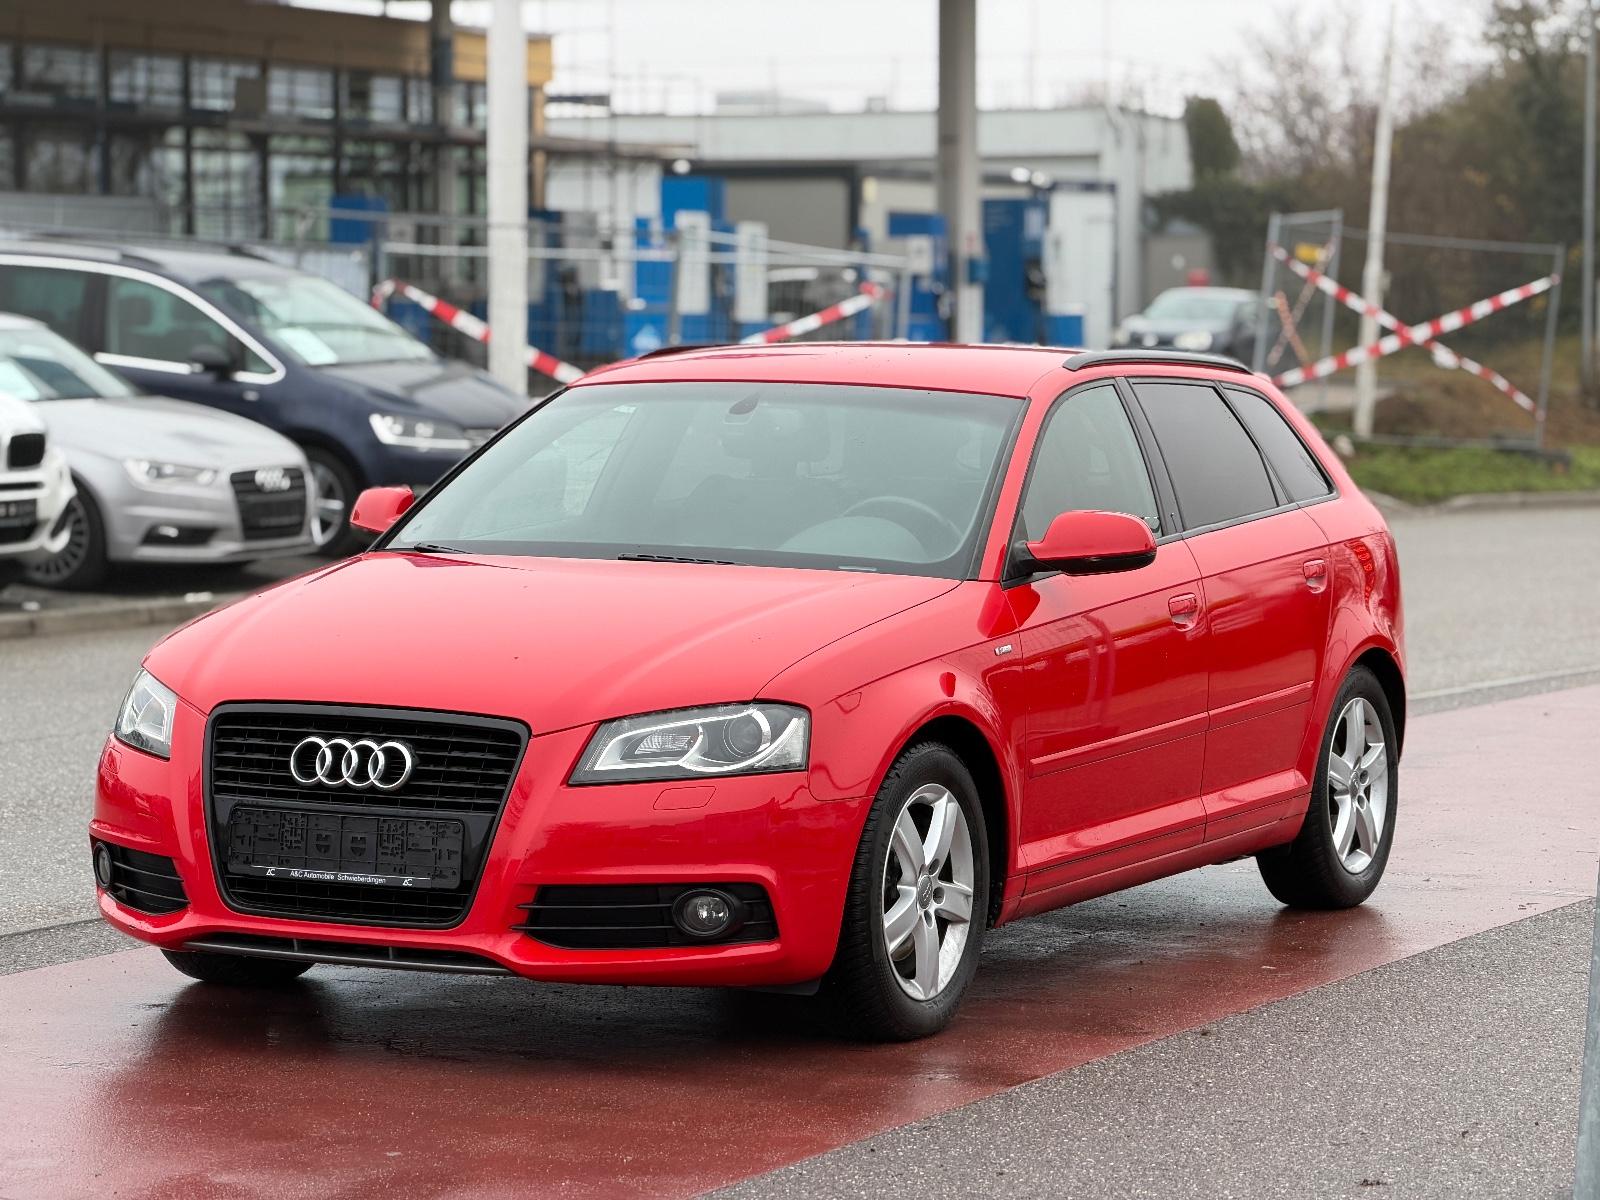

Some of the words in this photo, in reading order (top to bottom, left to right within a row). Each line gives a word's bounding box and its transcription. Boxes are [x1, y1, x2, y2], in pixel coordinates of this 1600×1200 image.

[289, 870, 303, 878] A&C
[303, 871, 335, 880] Automobile
[337, 873, 386, 885] Schwieberdingen
